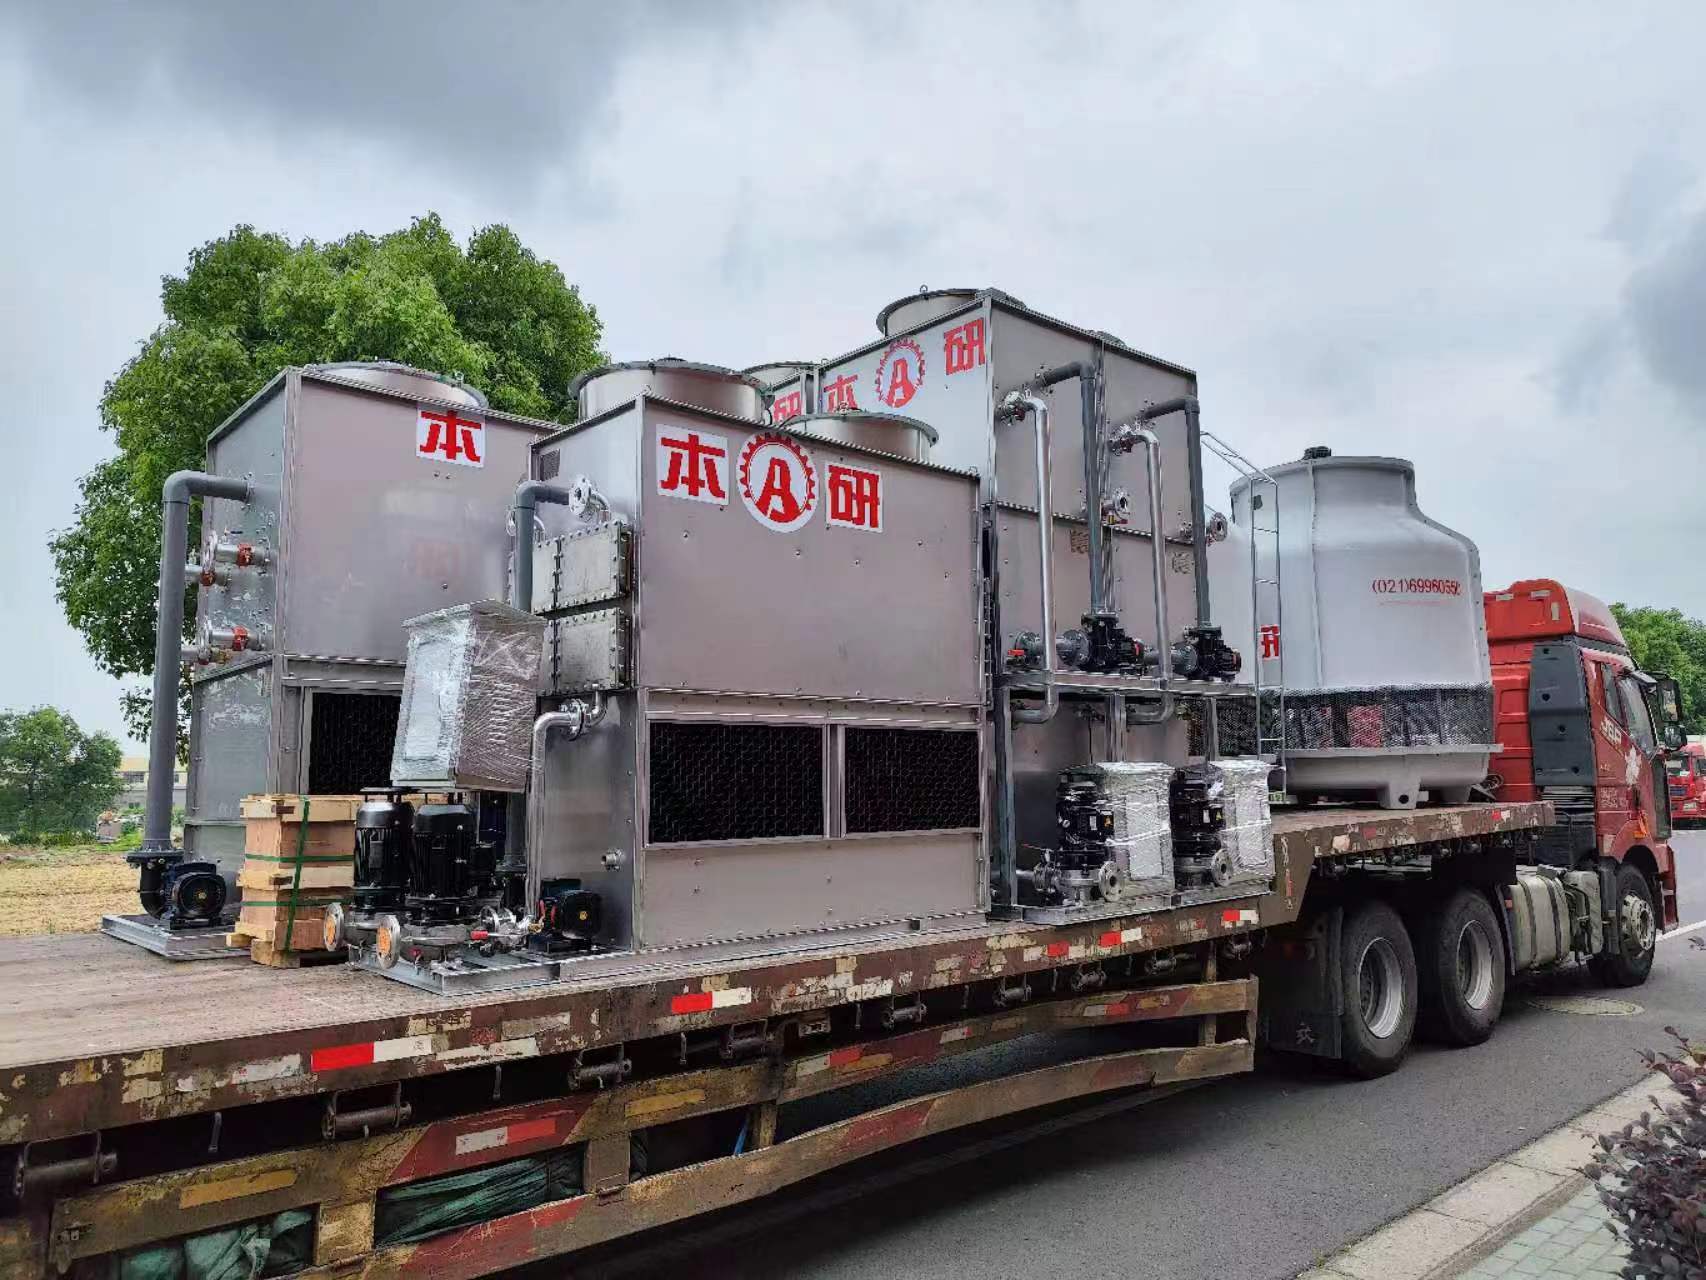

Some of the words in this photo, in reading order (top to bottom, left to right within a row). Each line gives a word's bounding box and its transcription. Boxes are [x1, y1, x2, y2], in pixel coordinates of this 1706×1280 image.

[944, 317, 986, 376] 研
[420, 409, 482, 463] 本
[660, 433, 726, 499] 本
[828, 464, 881, 528] 研
